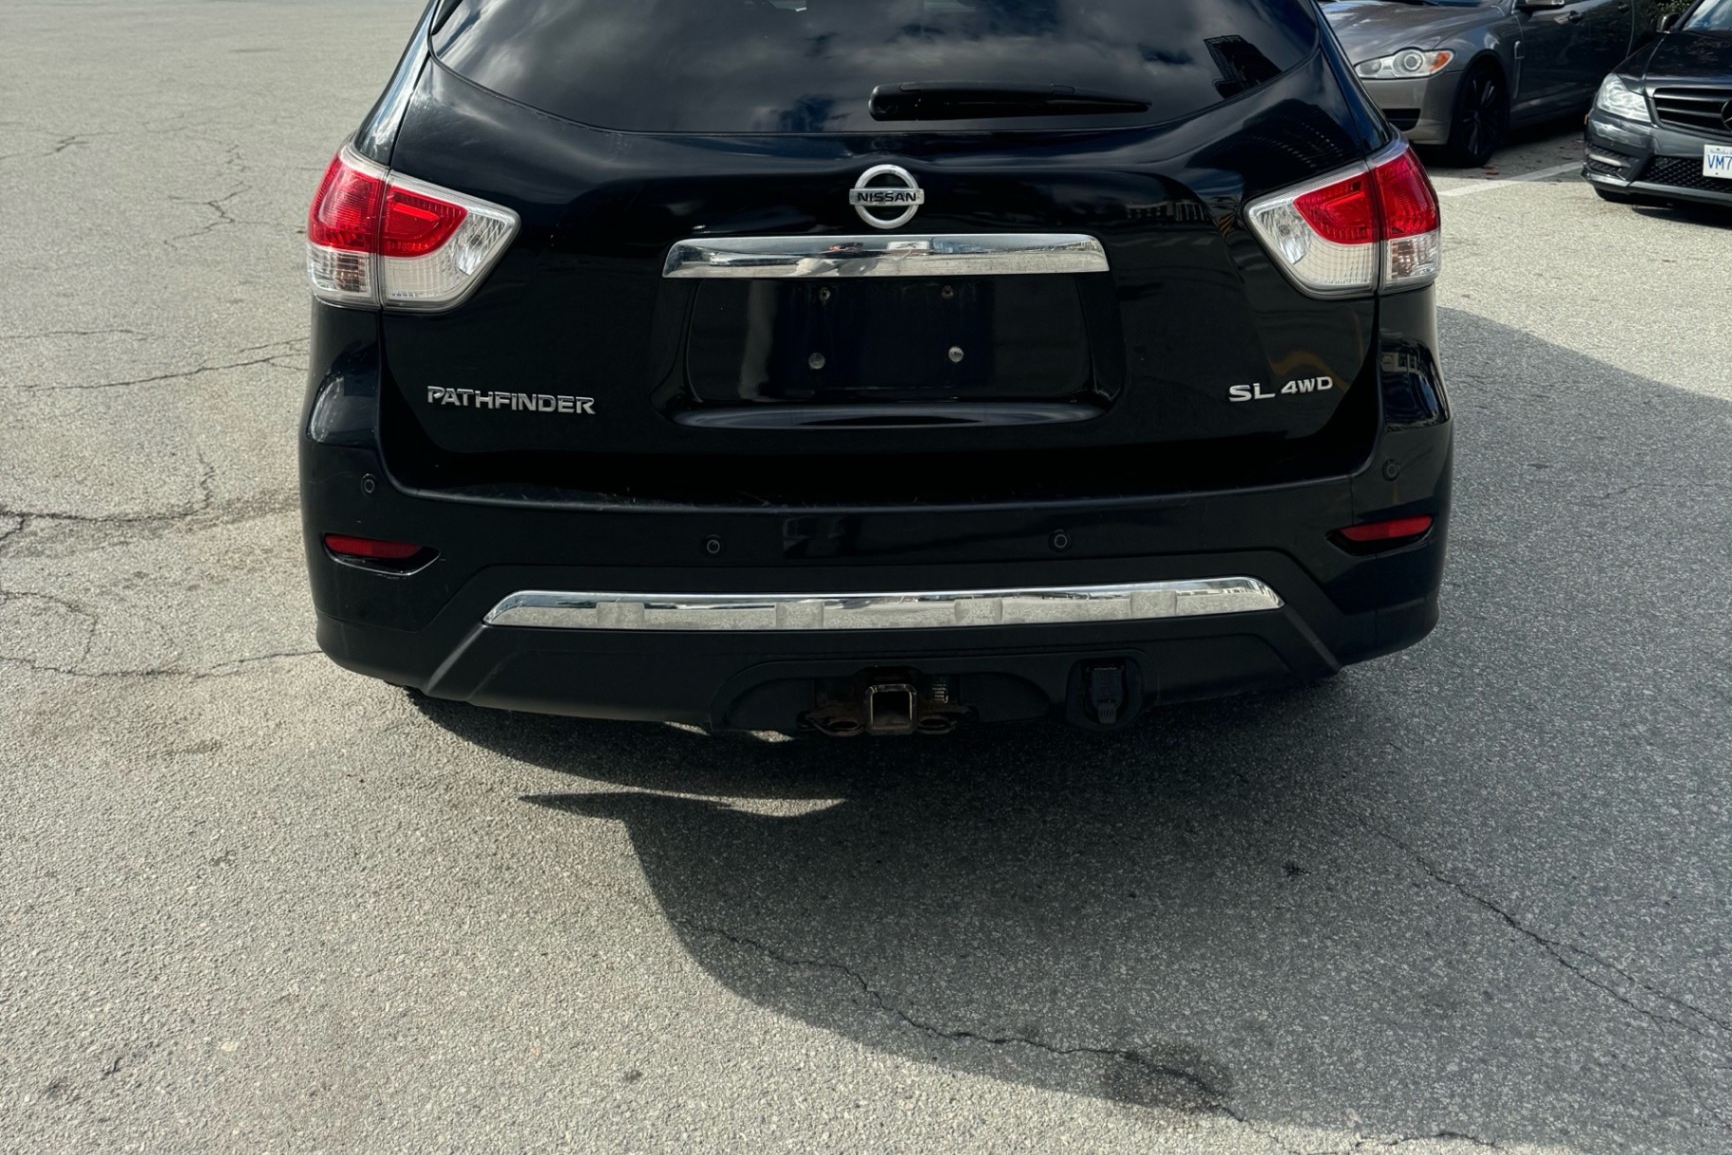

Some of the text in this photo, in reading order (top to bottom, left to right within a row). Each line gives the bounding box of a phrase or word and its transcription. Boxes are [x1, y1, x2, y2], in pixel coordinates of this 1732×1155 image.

[857, 192, 917, 202] NISSAN
[427, 385, 596, 414] PATHFINDER
[1228, 376, 1333, 402] SL 4WD
